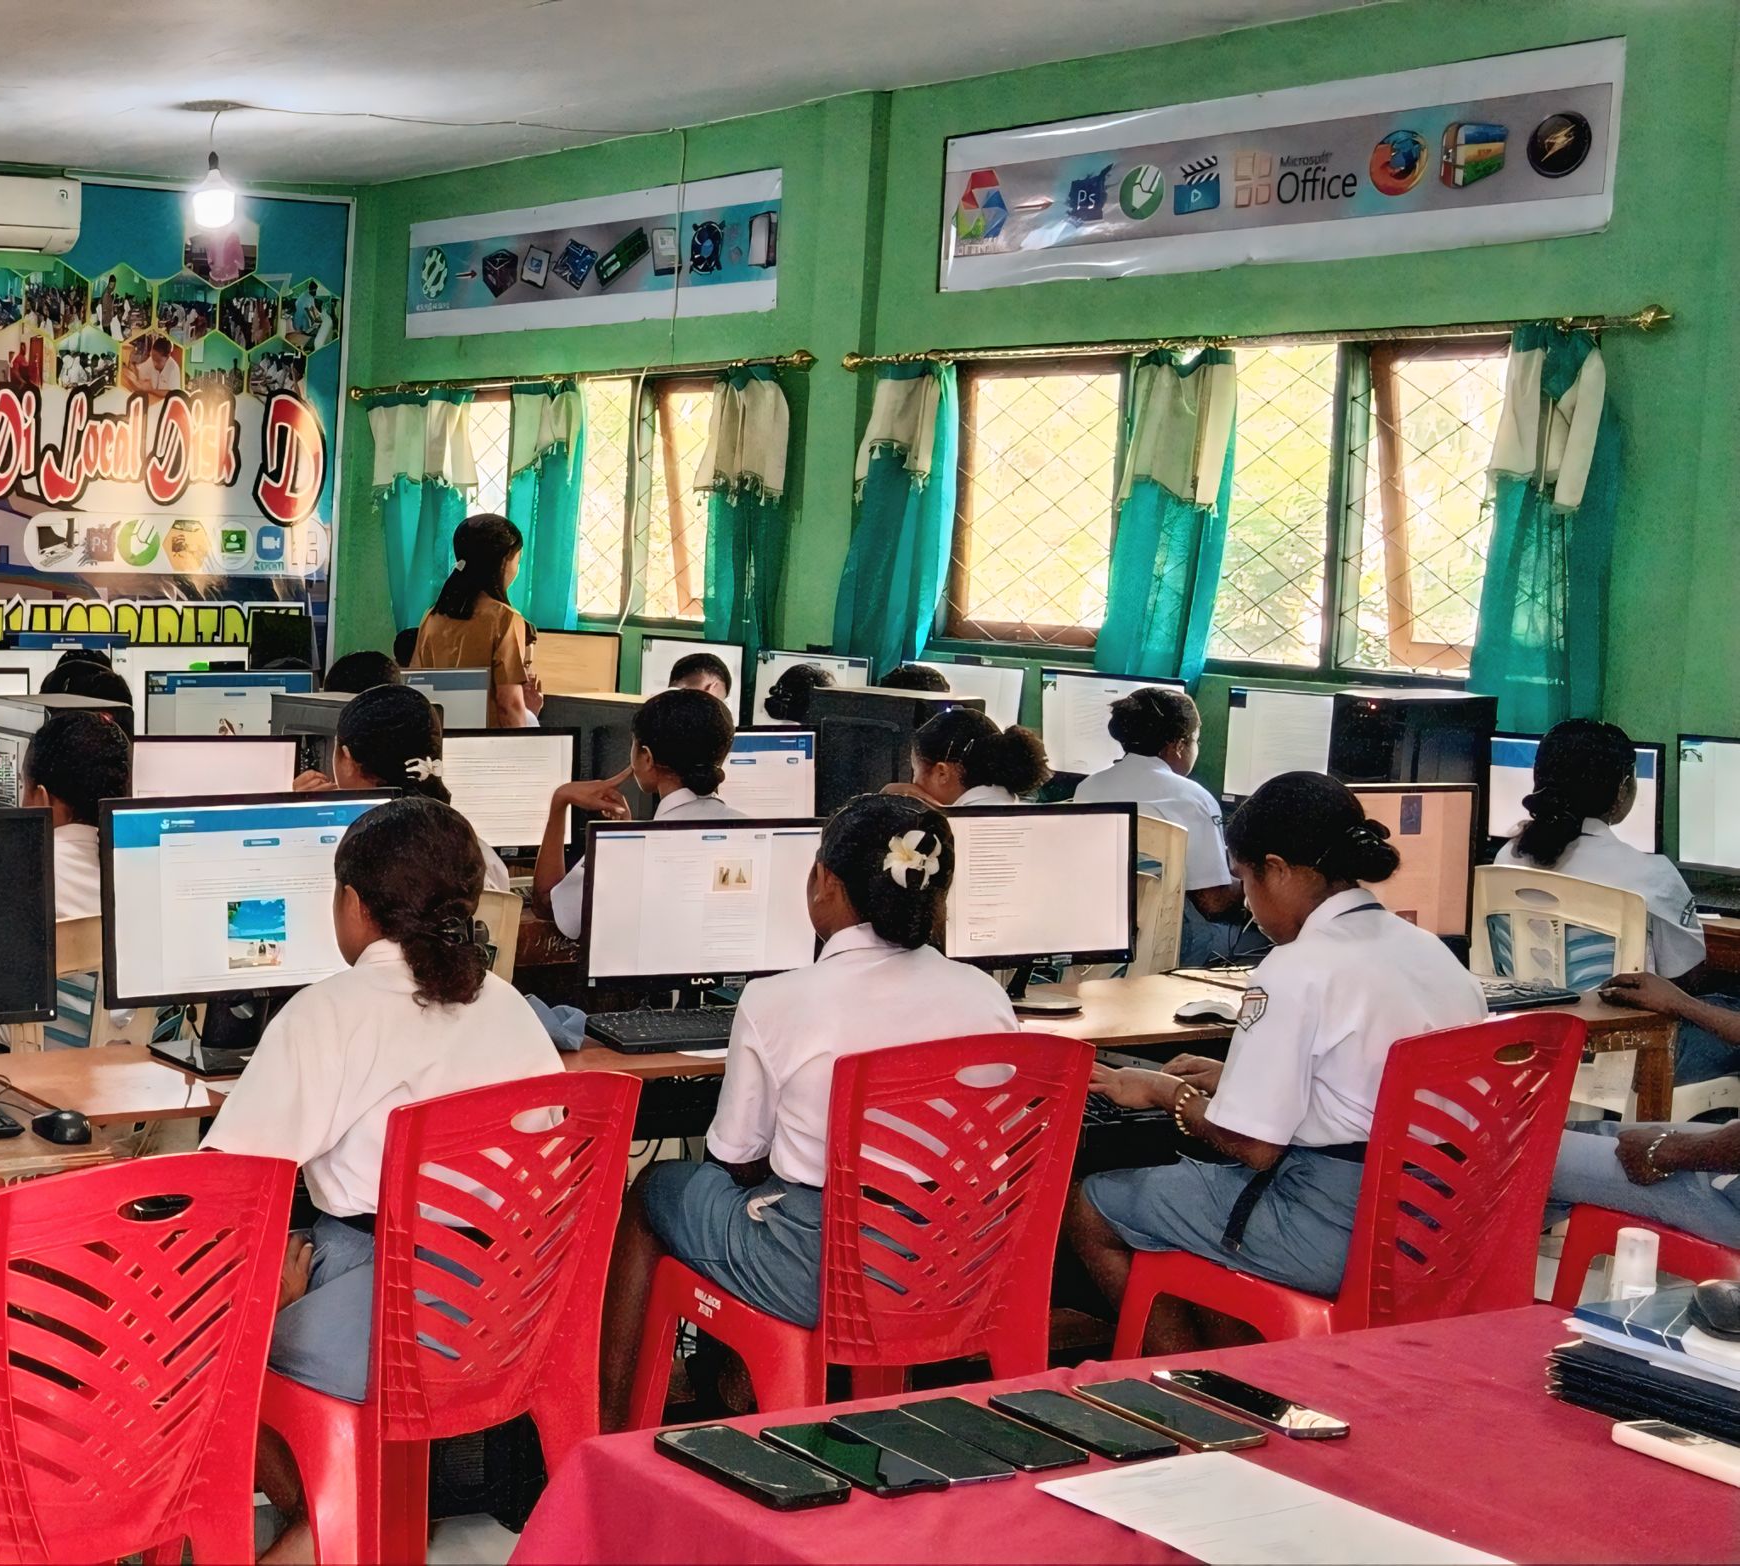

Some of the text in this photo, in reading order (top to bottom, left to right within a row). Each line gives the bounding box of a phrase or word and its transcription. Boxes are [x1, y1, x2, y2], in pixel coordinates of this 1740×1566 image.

[1076, 190, 1096, 210] Ps
[1277, 166, 1358, 204] Office
[40, 391, 145, 504] Local
[147, 393, 237, 503] Disk
[255, 392, 326, 525] D
